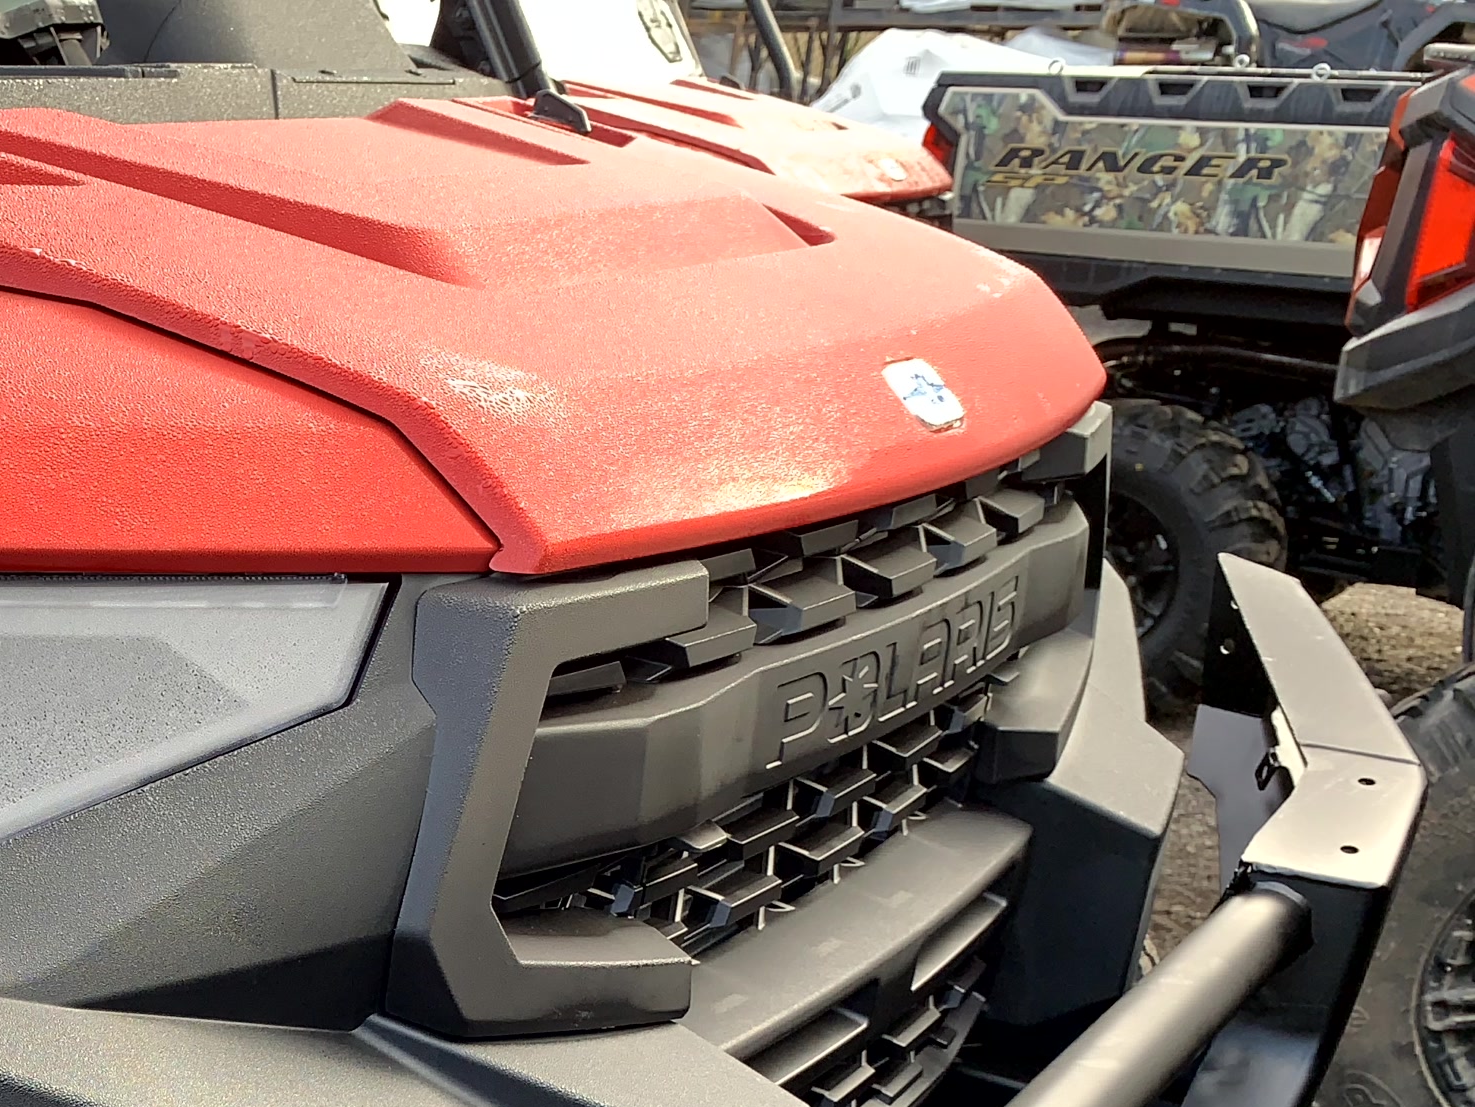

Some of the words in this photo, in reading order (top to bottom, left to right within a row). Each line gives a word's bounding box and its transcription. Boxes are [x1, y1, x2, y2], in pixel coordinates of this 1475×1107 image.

[984, 172, 1070, 187] SP
[992, 146, 1291, 184] RANGER
[765, 576, 1019, 769] POLARIS
